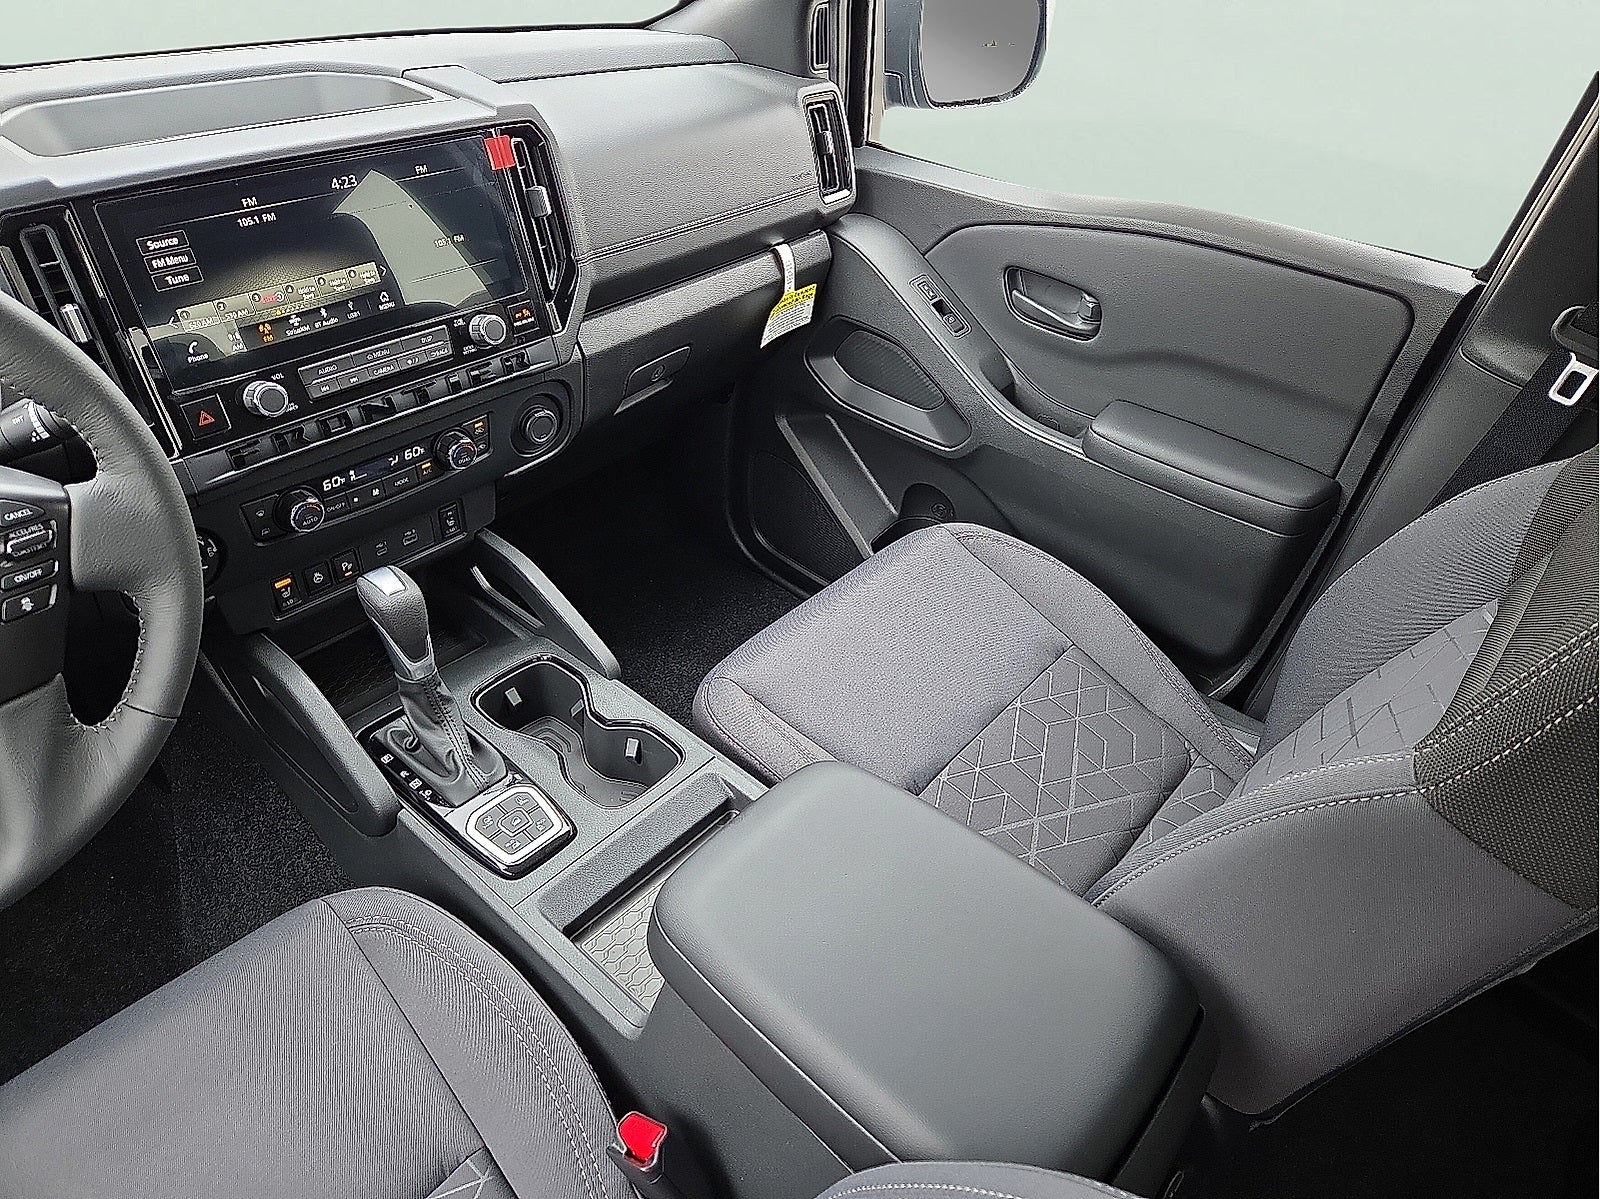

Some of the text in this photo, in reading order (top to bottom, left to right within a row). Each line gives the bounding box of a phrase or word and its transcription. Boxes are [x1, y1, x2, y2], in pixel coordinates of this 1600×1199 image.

[415, 165, 428, 173] FM
[331, 175, 358, 190] 4:23
[241, 196, 258, 207] FM
[236, 212, 277, 228] 105.1 FM
[147, 236, 179, 250] Source
[152, 254, 189, 268] FM Menu
[165, 274, 190, 286] Tune
[187, 353, 210, 363] Phone
[271, 372, 285, 380] VOL
[317, 364, 338, 376] AUDIO
[227, 350, 530, 471] FRONTIER
[4, 508, 34, 521] CANCEL
[302, 516, 319, 527] AUTO
[14, 568, 43, 583] ON/OFF
